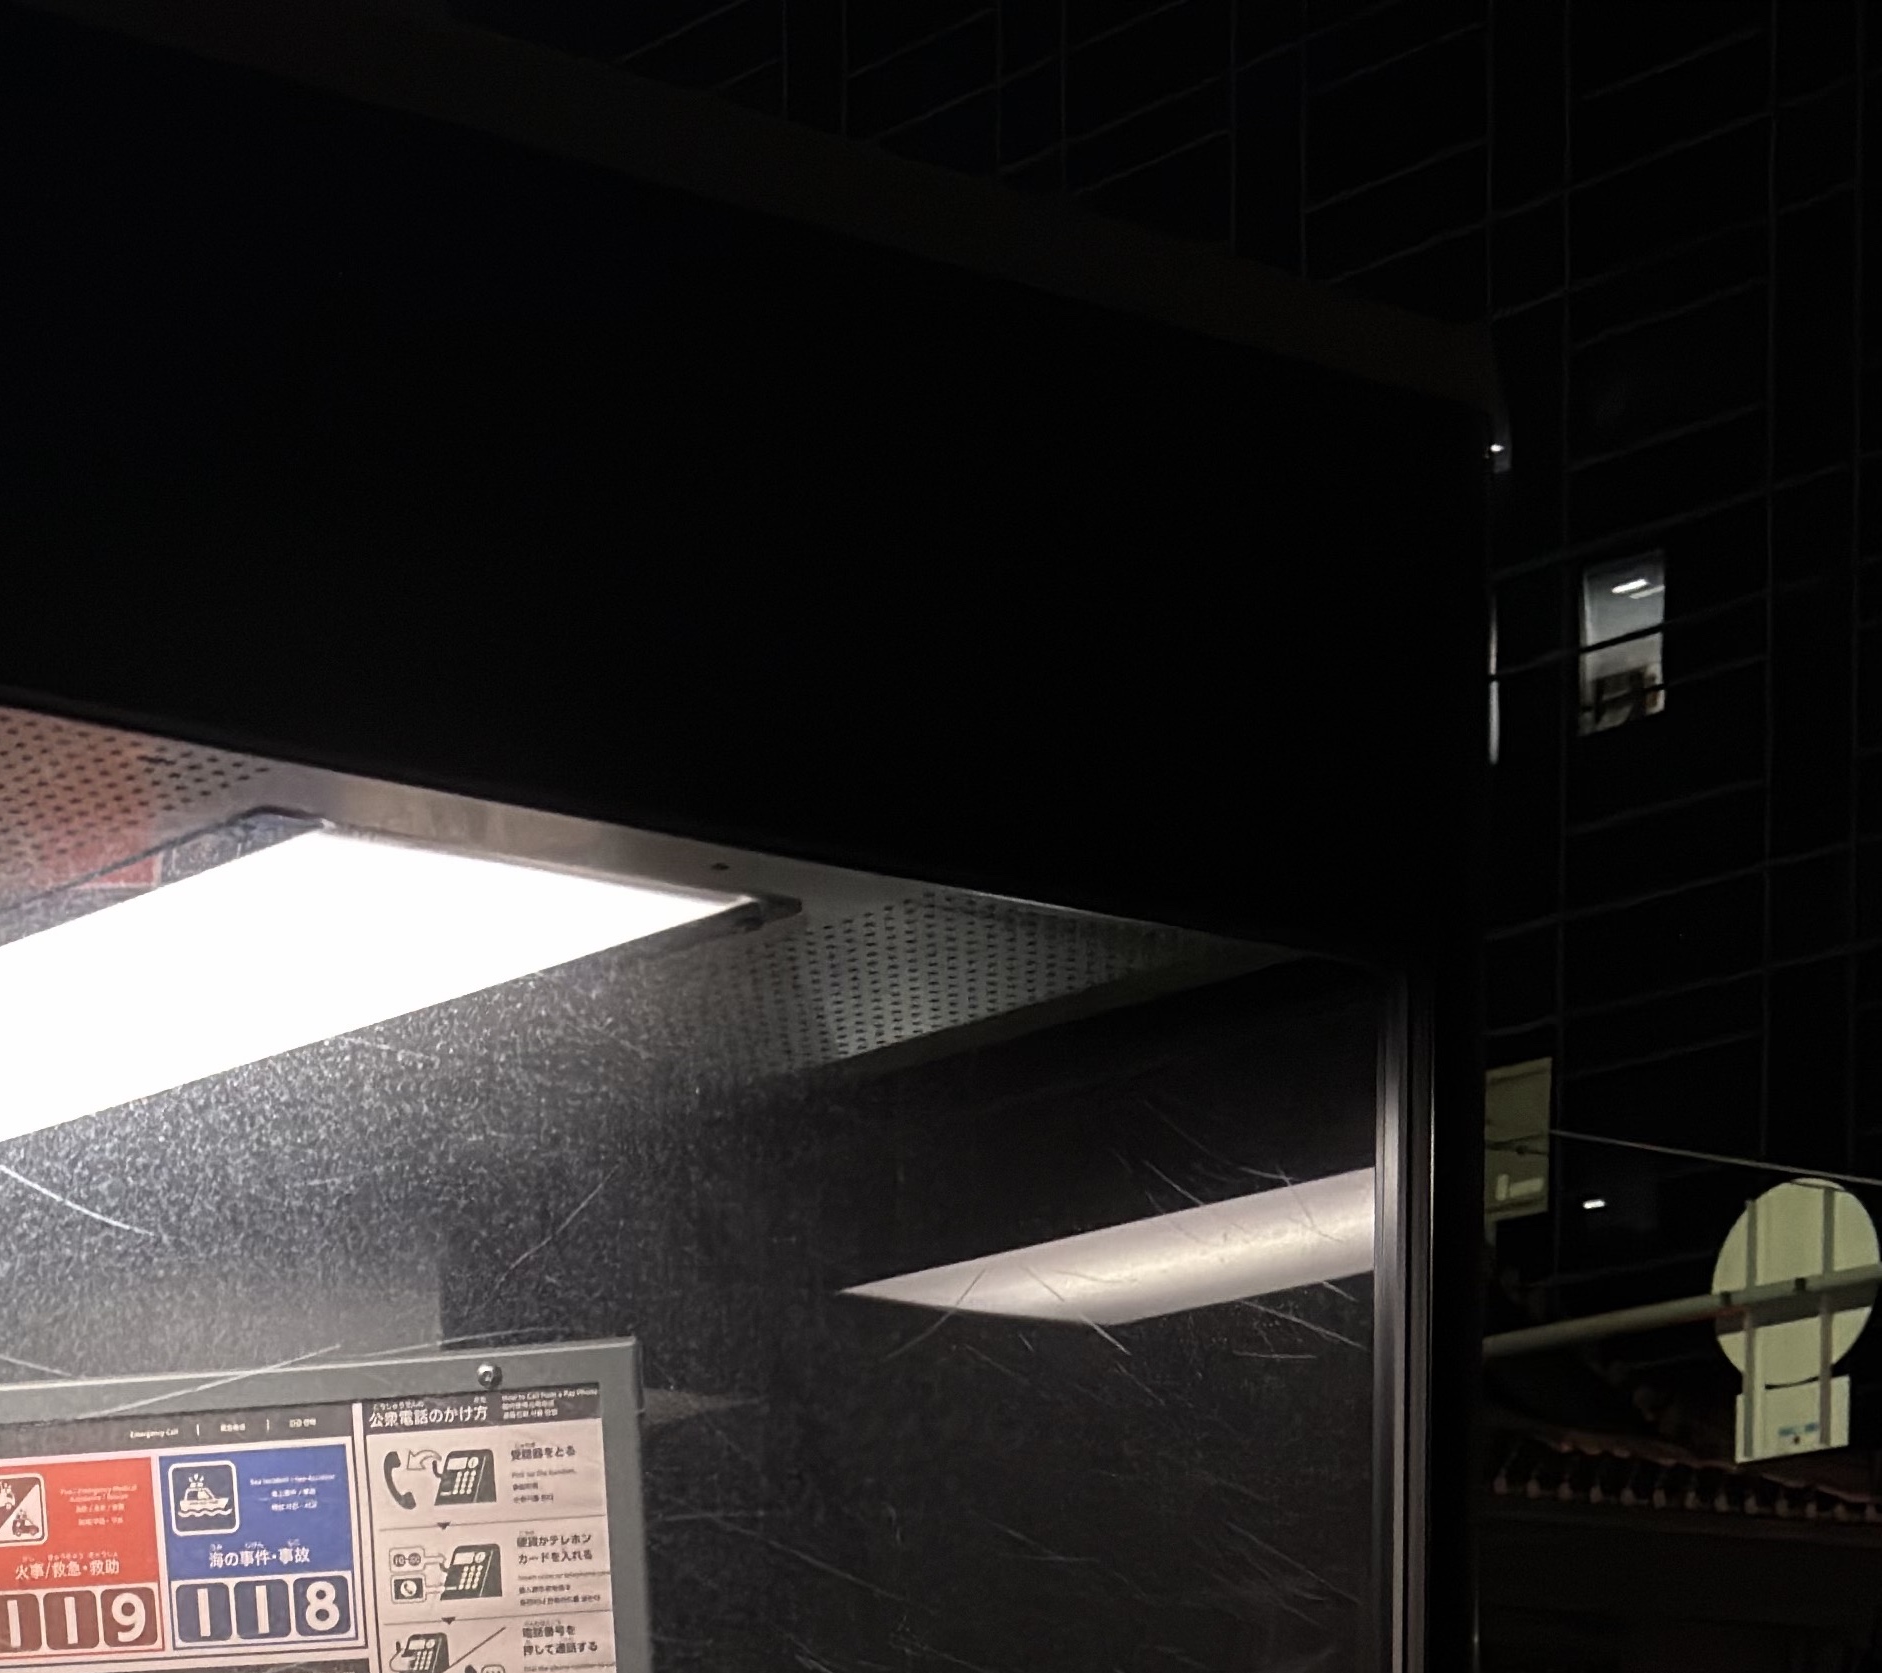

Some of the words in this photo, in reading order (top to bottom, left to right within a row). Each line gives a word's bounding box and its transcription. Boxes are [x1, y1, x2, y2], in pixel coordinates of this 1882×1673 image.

[129, 1428, 164, 1439] Emergency
[165, 1427, 178, 1436] Call
[369, 1405, 488, 1429] 公衆電話のかけ方
[7, 1592, 146, 1648] 119
[197, 1581, 340, 1637] 118
